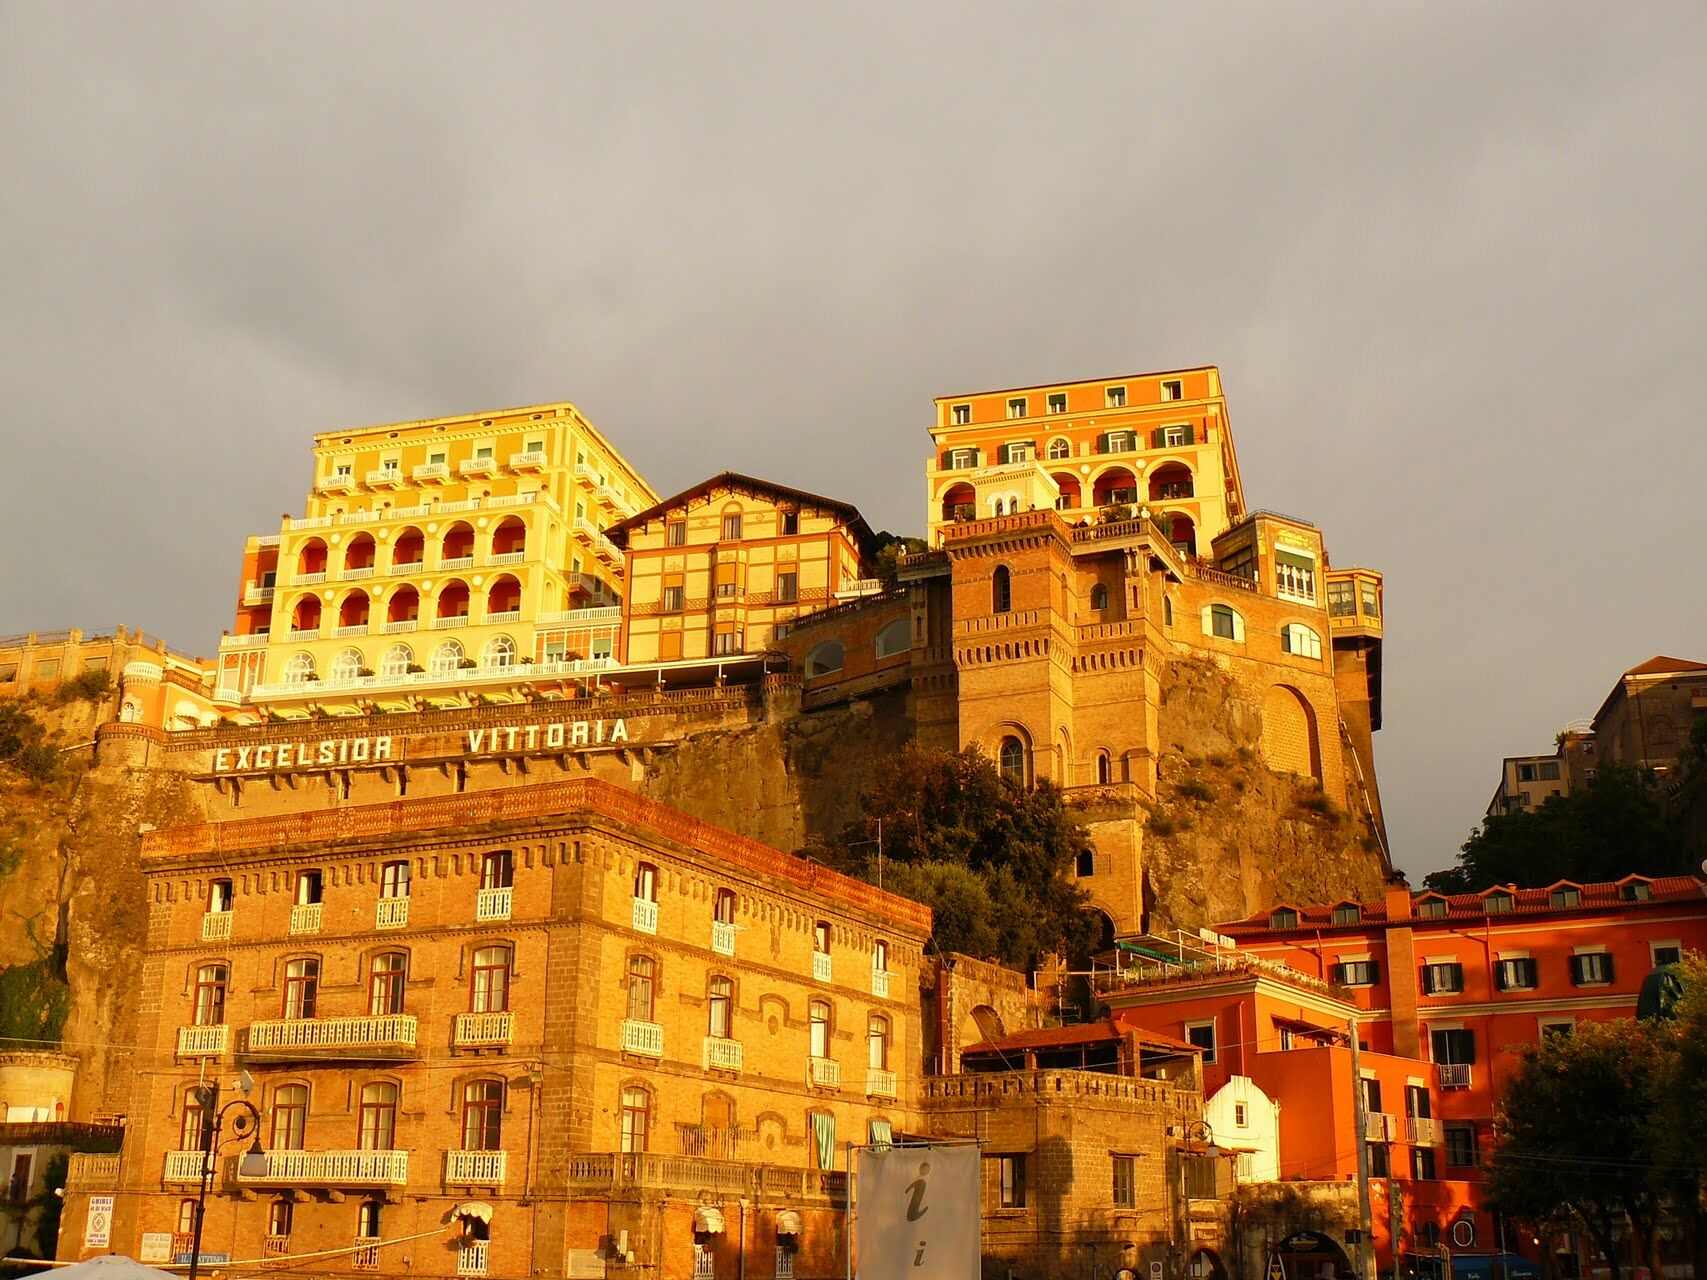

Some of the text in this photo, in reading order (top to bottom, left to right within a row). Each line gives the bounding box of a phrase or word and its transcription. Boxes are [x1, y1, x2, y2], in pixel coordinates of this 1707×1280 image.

[216, 719, 629, 771] EXCELSIOR VITTORIA
[905, 1162, 929, 1222] i
[189, 1254, 224, 1263] ATTINO
[914, 1241, 926, 1267] i
